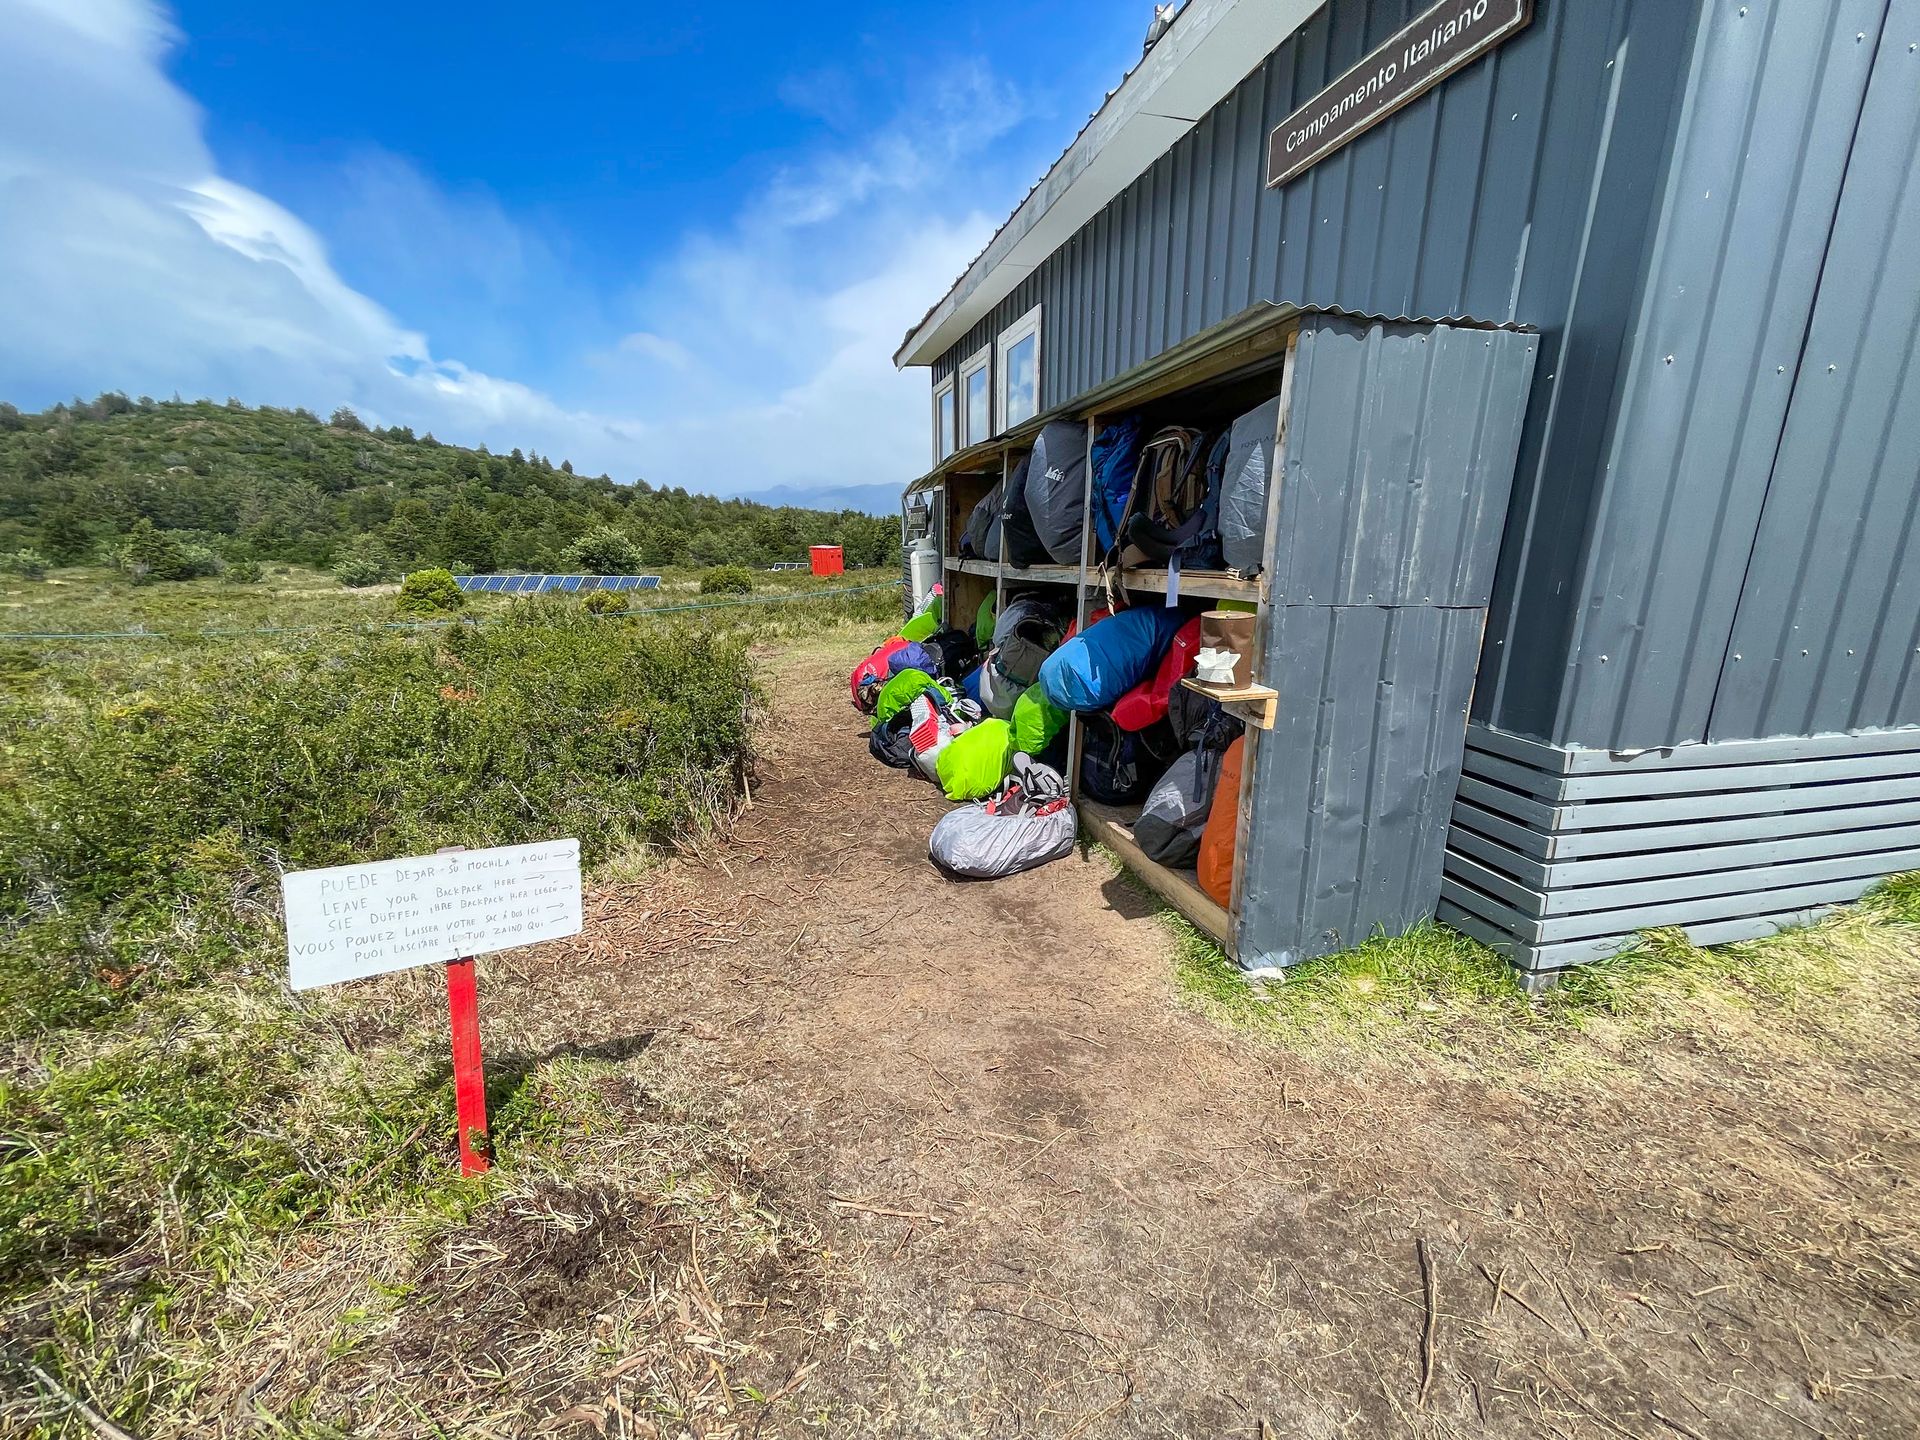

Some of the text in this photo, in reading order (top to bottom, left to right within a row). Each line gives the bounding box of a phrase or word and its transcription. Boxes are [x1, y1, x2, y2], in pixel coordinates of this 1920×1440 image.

[1286, 0, 1488, 152] Campamento Italiano
[321, 874, 377, 895] PUEDE
[396, 867, 435, 882] DEJAR
[449, 866, 459, 874] SU
[323, 878, 516, 916] LEAVE YOUR BACKPACK HERE
[294, 939, 335, 956] VOUS
[346, 932, 394, 948] POUVEZ
[405, 926, 438, 937] LAISSER
[446, 919, 475, 930] VOTRE
[511, 910, 523, 918] DOS
[527, 907, 538, 916] ICI
[328, 917, 353, 932] SIE
[461, 895, 504, 909] BACKPACK
[354, 949, 383, 962] PUOI
[449, 933, 457, 943] IL
[467, 931, 485, 940] TUO
[493, 924, 522, 934] ZAINO
